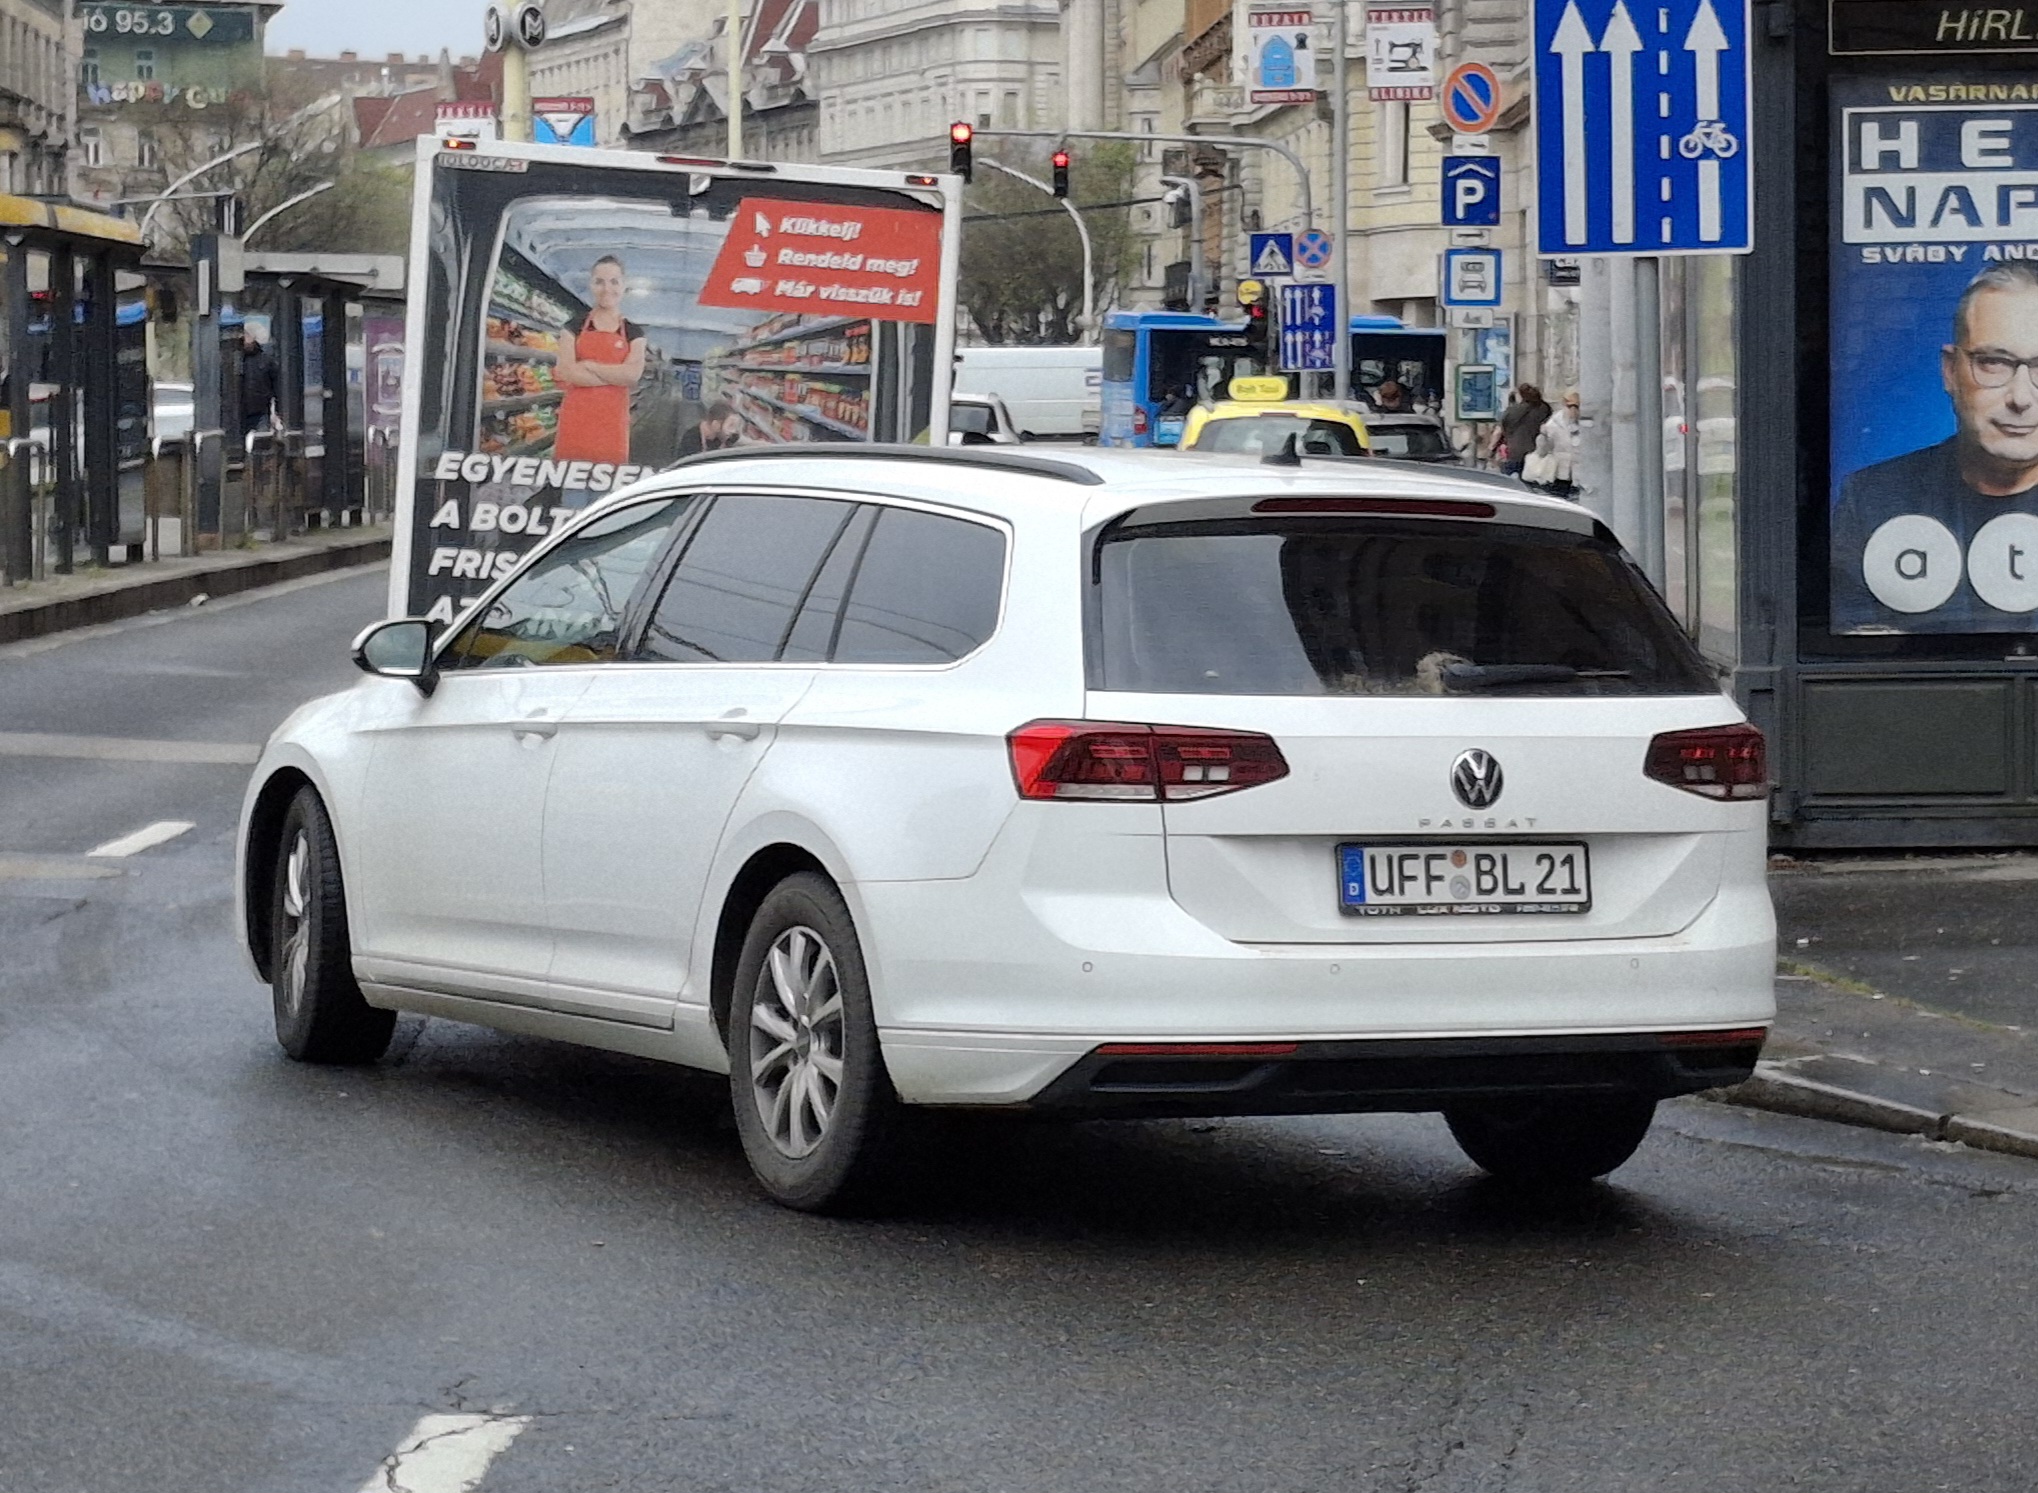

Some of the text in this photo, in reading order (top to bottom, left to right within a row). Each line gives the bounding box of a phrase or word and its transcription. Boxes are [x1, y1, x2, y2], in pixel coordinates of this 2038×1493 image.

[115, 9, 175, 36] 95.3
[1456, 179, 1485, 219] P
[777, 249, 920, 277] Rendeld meg!
[774, 279, 923, 307] Már visszük is!
[429, 499, 460, 529] A
[1418, 818, 1537, 829] PASSAT
[1369, 853, 1447, 896] UFF
